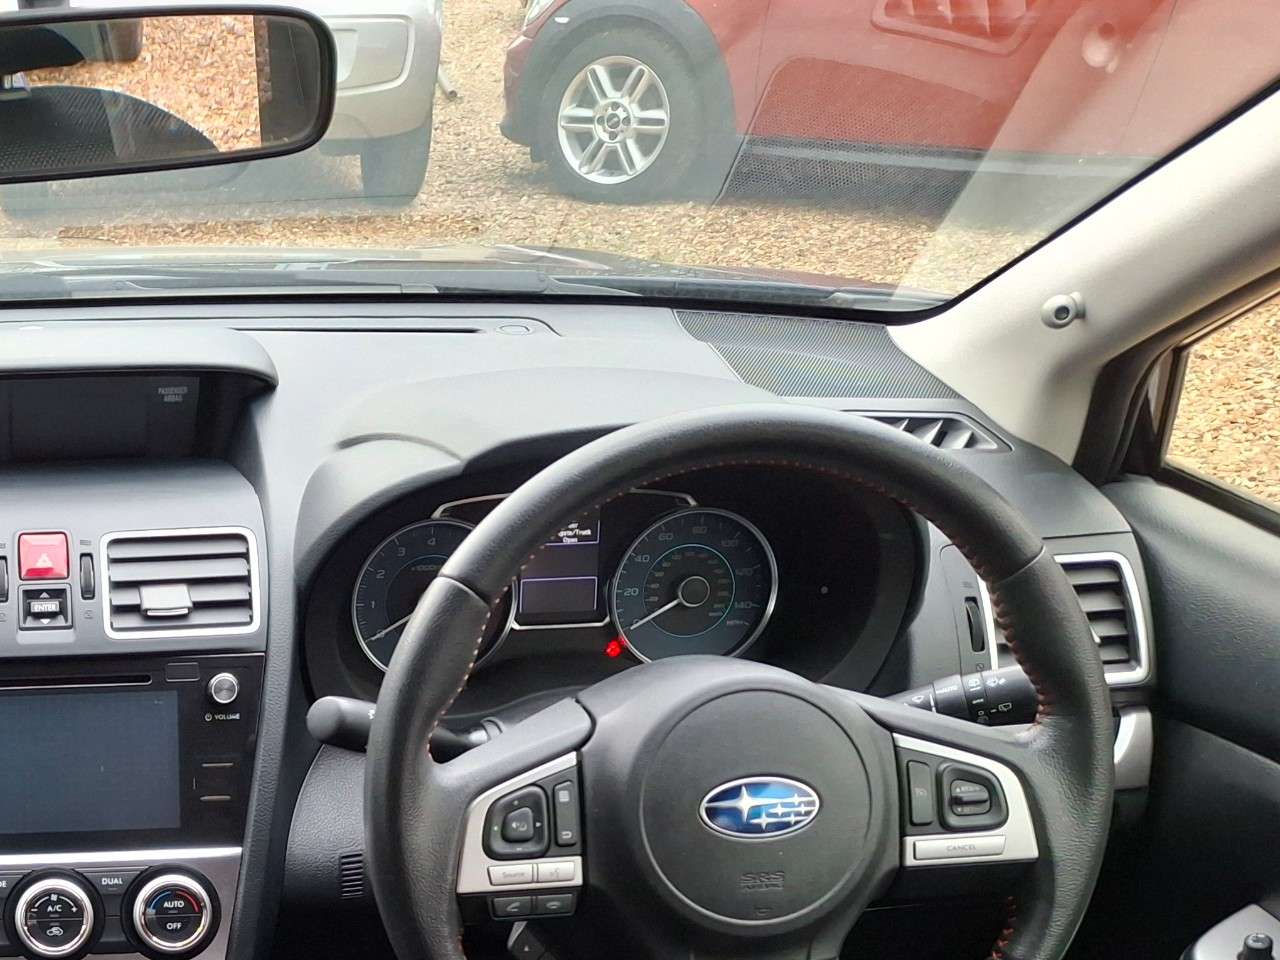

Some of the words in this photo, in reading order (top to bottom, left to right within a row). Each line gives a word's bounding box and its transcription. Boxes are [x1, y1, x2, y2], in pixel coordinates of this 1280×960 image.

[658, 532, 674, 541] 60
[397, 547, 407, 557] 3
[634, 554, 650, 563] 40
[375, 569, 386, 579] 2
[623, 587, 639, 597] 20
[33, 603, 57, 612] ENTER
[214, 712, 241, 720] VOLUME
[946, 843, 977, 853] CANCEL
[101, 877, 123, 885] DUAL
[740, 871, 785, 883] SRS
[47, 904, 63, 912] A/C
[166, 922, 182, 930] OFF
